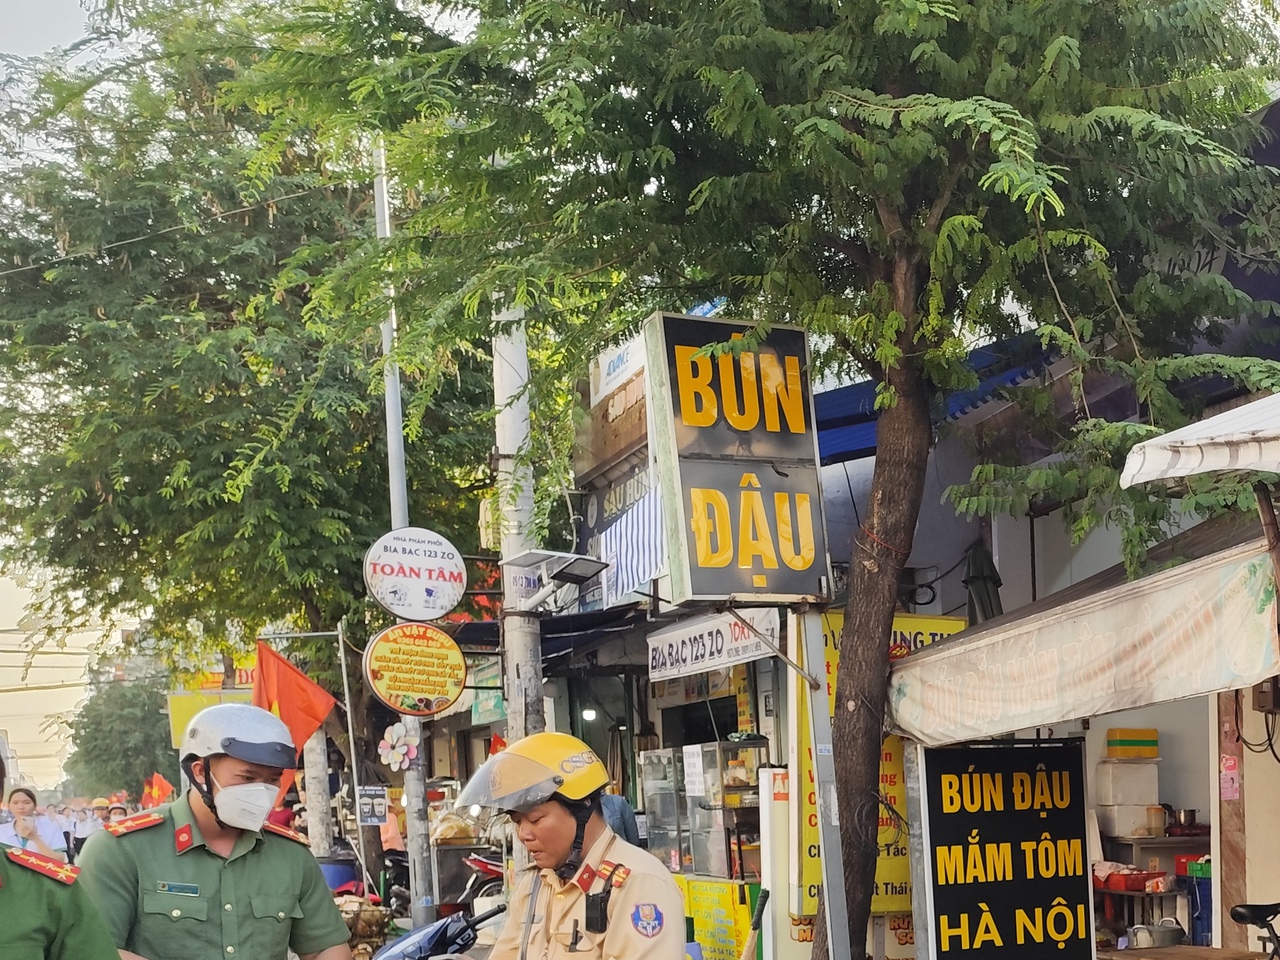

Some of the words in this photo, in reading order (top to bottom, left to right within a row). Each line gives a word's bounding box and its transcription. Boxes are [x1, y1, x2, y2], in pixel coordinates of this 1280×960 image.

[674, 332, 807, 434] BÚN
[383, 545, 399, 554] BIA
[423, 549, 438, 559] 123
[440, 551, 455, 560] ZO
[690, 472, 816, 588] ĐẬU
[370, 561, 422, 580] TOÀN
[425, 566, 464, 583] TÂM
[651, 645, 667, 672] BIA
[688, 633, 706, 665] 123
[708, 628, 724, 660] ZO
[940, 764, 1003, 814] BÚN
[1012, 763, 1071, 819] ĐẬU
[885, 842, 907, 857] Tắc
[936, 828, 1013, 885] MẮM
[1020, 832, 1083, 879] TÔM
[883, 882, 907, 895] Thái
[939, 902, 1004, 952] HÀ
[1014, 896, 1087, 950] NỘI
